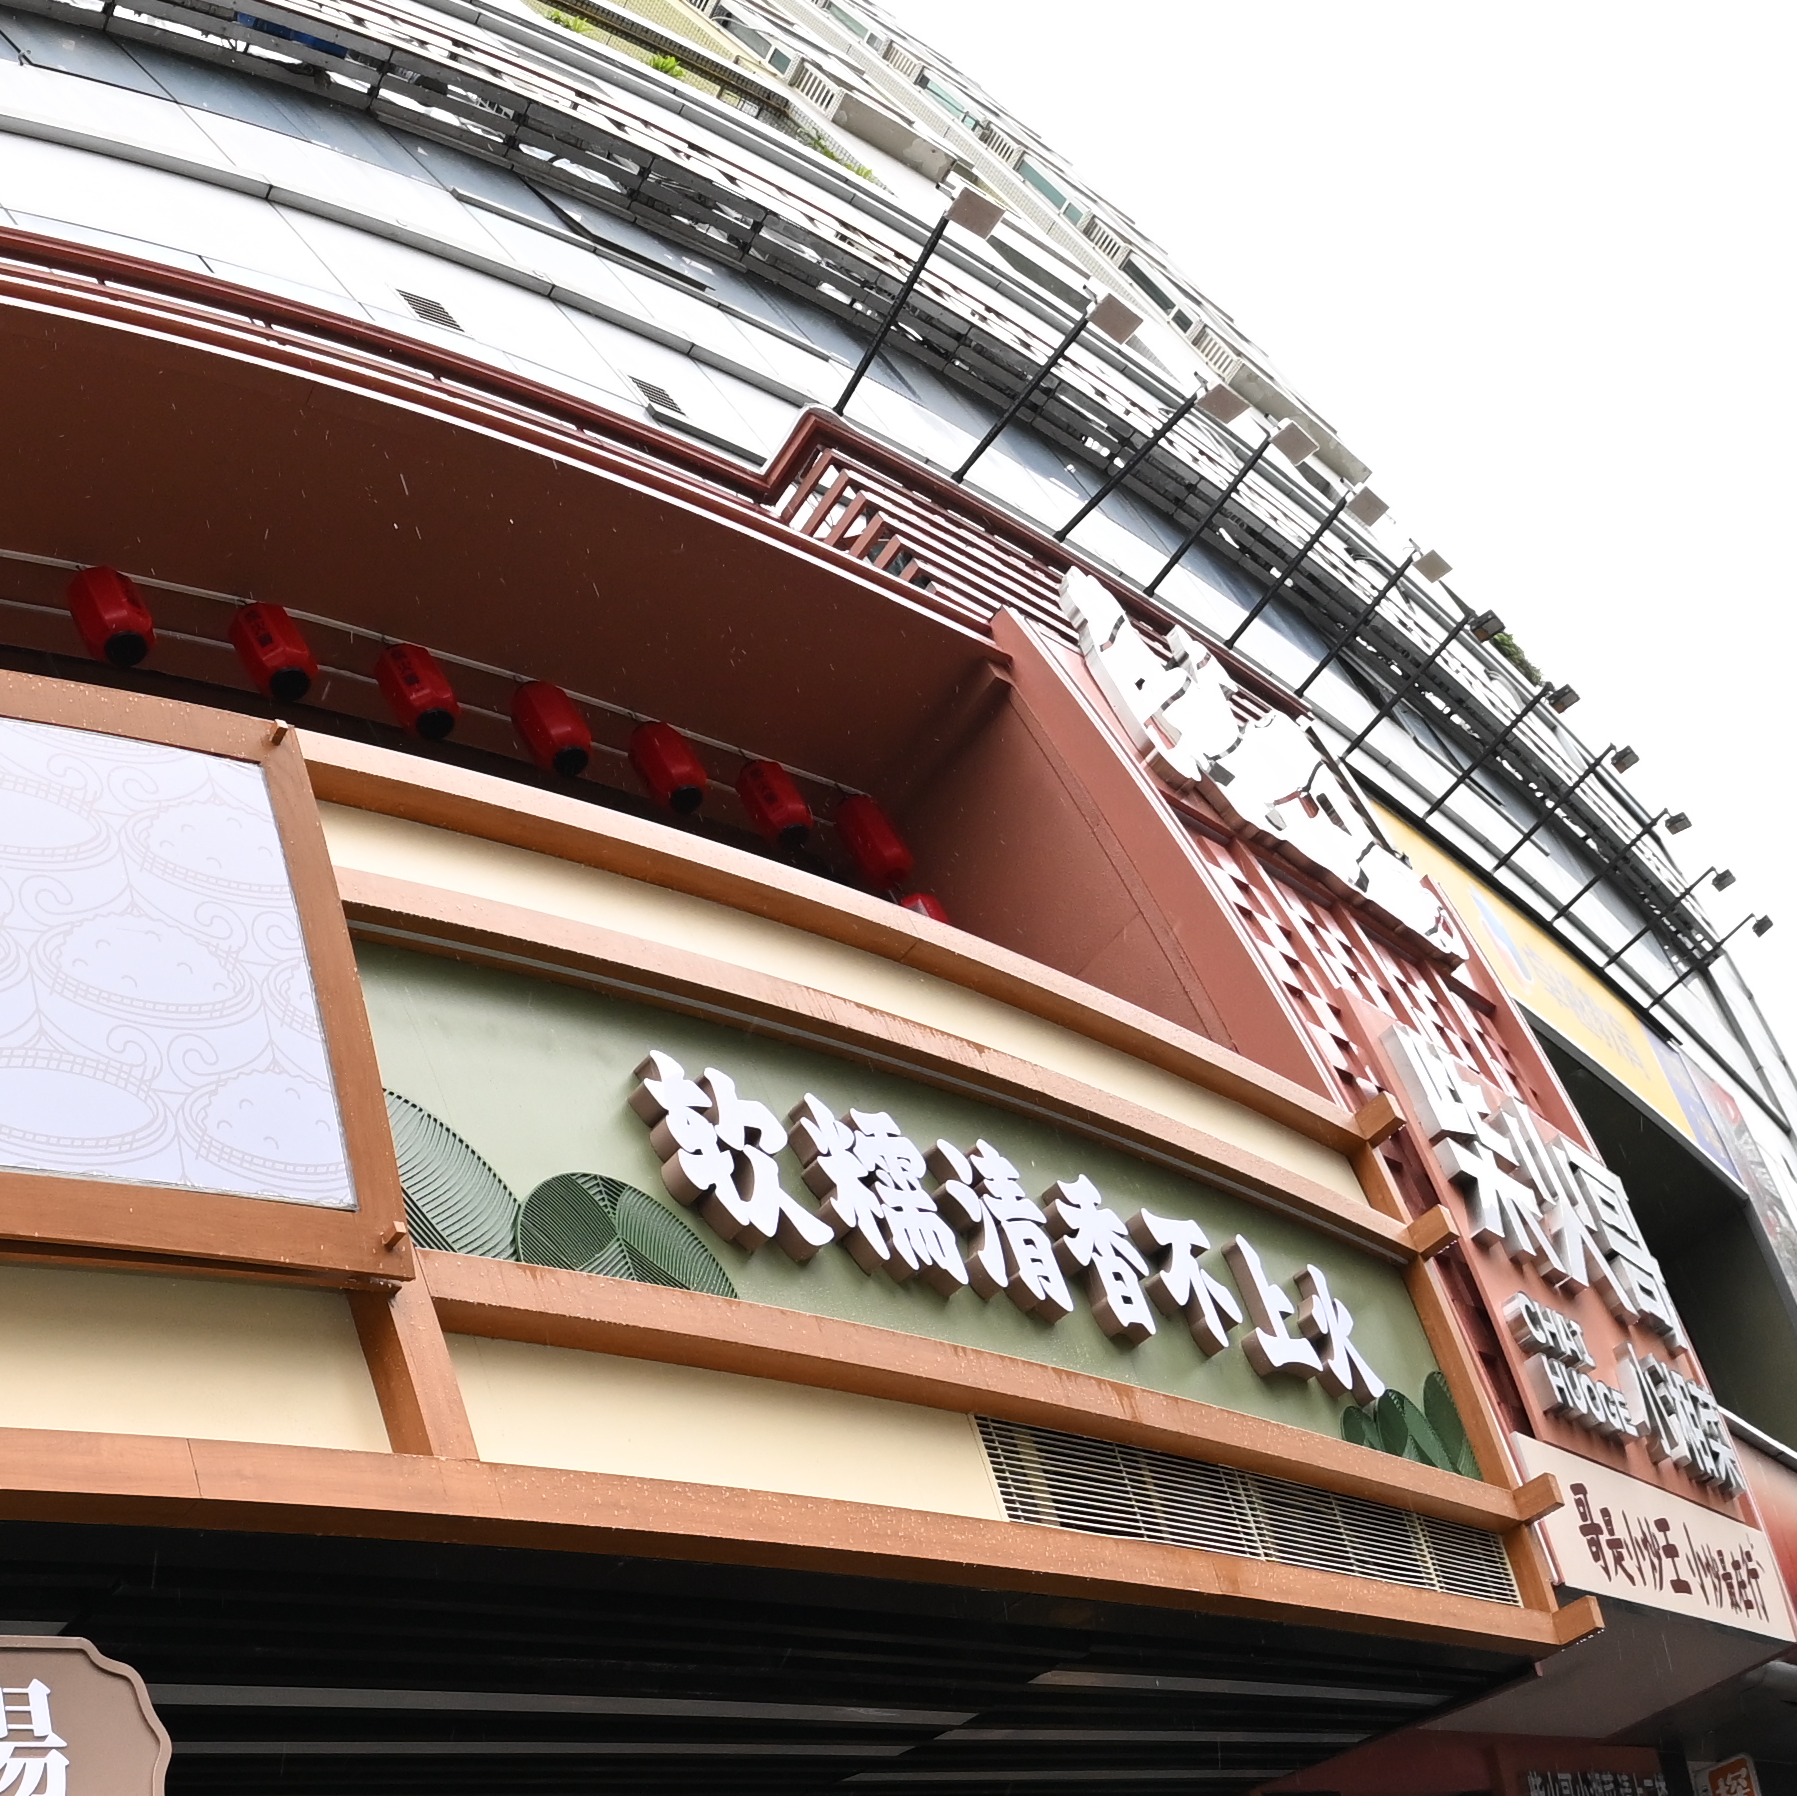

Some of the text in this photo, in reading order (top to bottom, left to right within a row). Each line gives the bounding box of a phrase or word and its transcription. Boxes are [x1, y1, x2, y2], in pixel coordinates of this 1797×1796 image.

[633, 1049, 1386, 1401] 软糯清香不上火
[1513, 1291, 1596, 1372] CHAI
[1542, 1353, 1639, 1438] HUOGE
